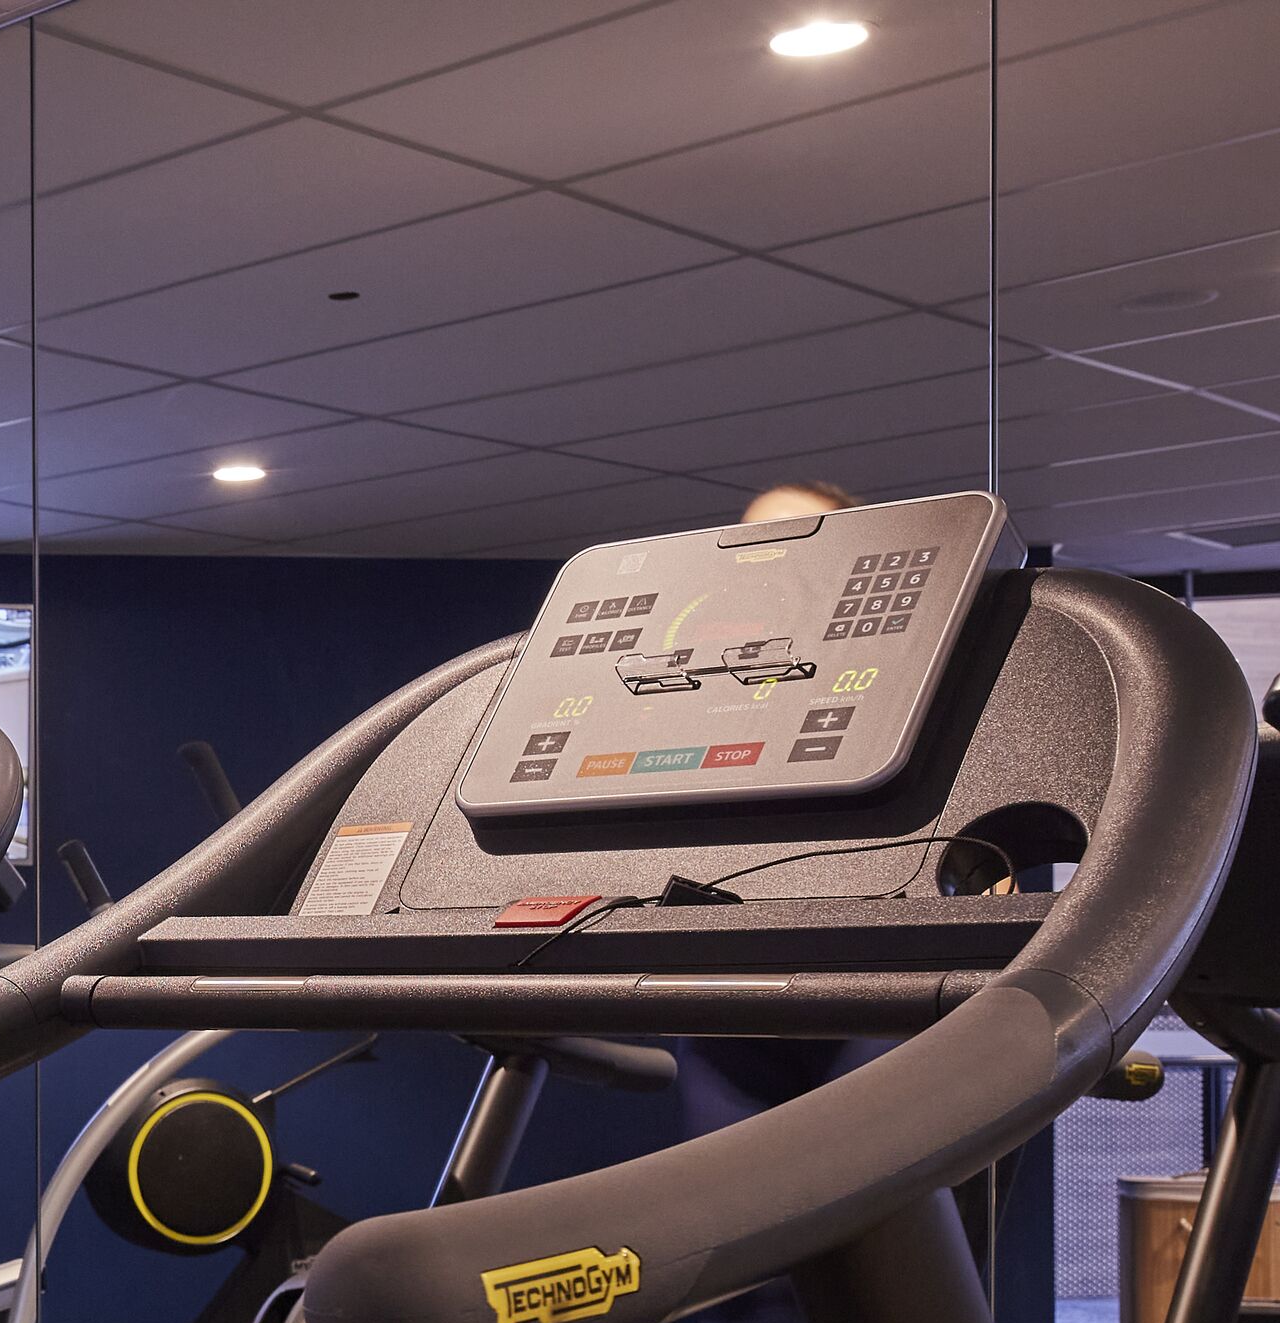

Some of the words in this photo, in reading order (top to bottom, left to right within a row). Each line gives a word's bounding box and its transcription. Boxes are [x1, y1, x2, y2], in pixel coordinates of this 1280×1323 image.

[862, 560, 871, 569] 1
[889, 556, 901, 566] 2
[919, 552, 931, 562] 3
[852, 581, 863, 591] 4
[880, 577, 892, 588] 5
[910, 574, 921, 584] 6
[843, 603, 854, 614] 7
[870, 600, 882, 610] 8
[901, 596, 912, 607] 9
[861, 622, 873, 632] 0
[832, 668, 879, 693] 0.0
[753, 678, 778, 700] 0
[706, 703, 750, 714] CALORIES
[808, 696, 838, 706] SPEED
[643, 752, 695, 767] START
[714, 749, 752, 762] STOP
[587, 757, 627, 771] PAUSE
[494, 1263, 632, 1318] TECHNOGYM
